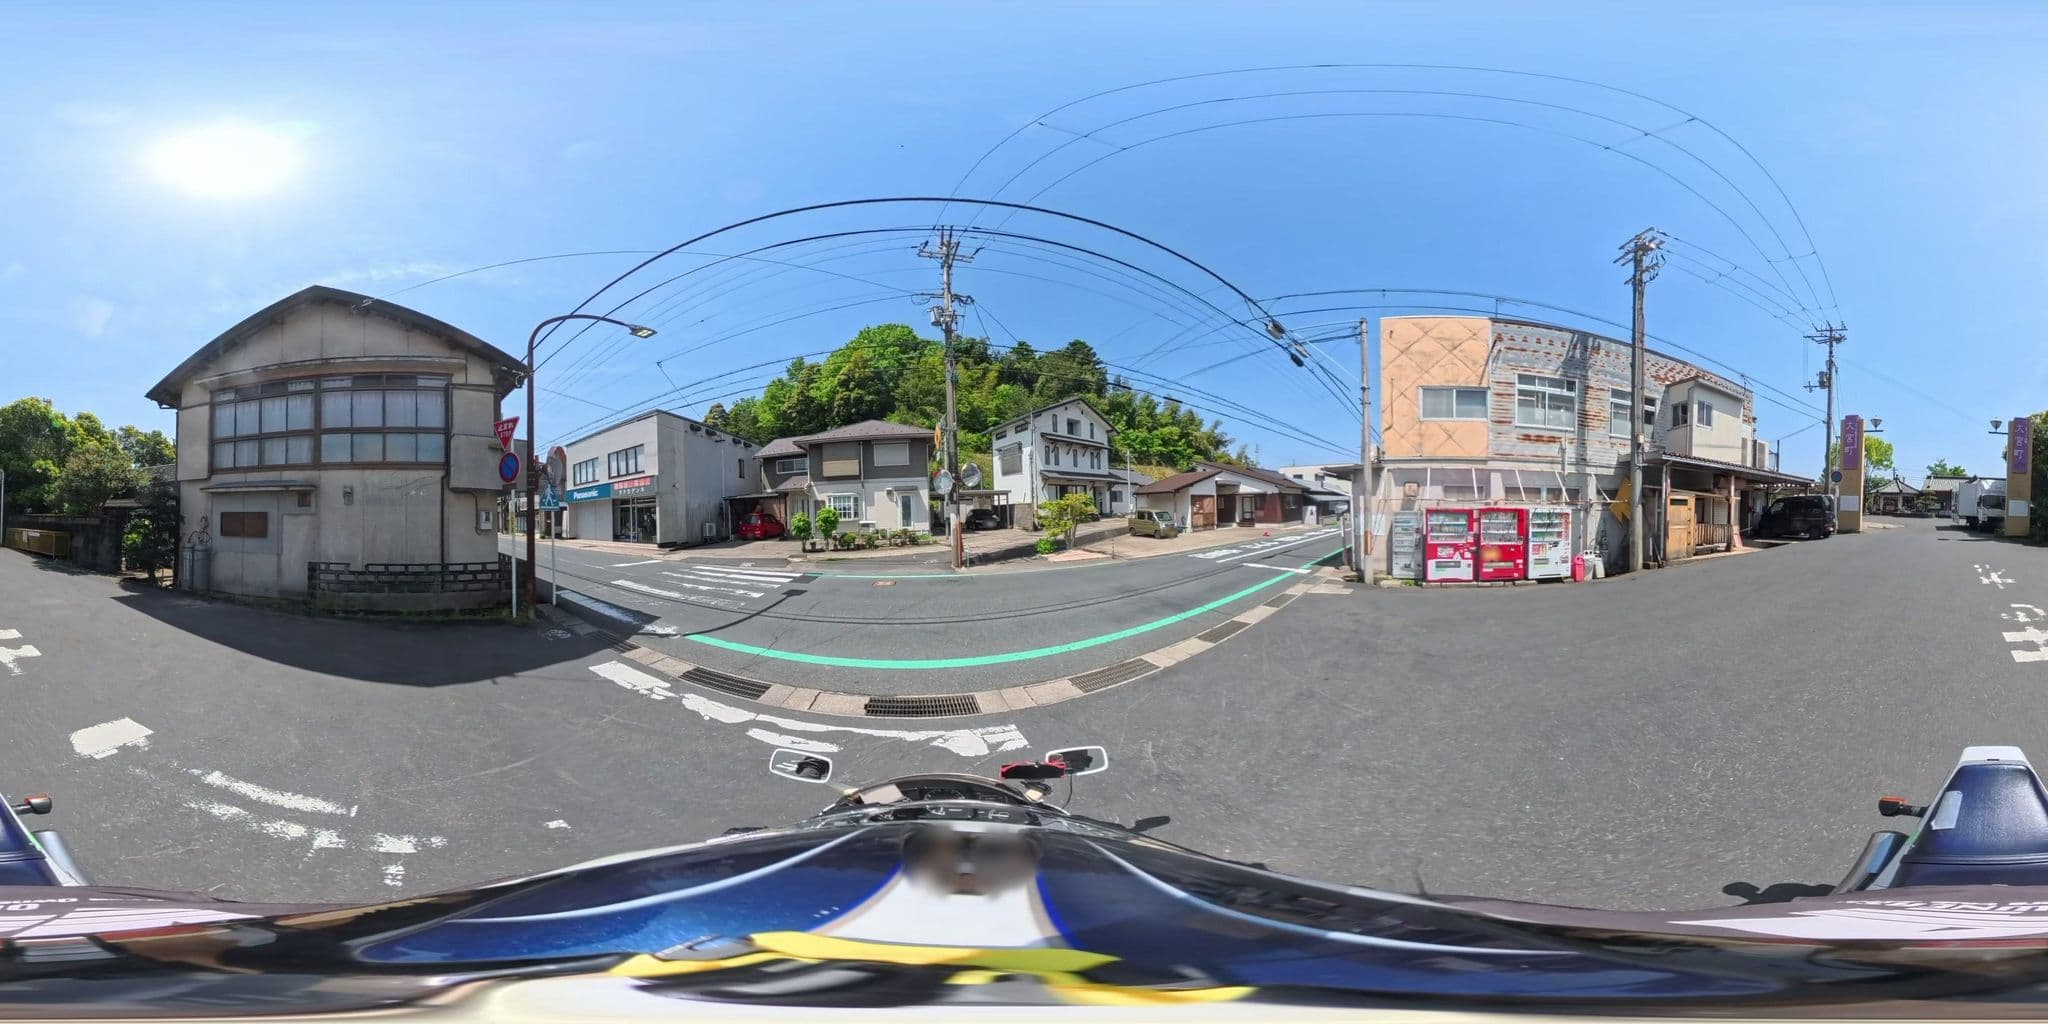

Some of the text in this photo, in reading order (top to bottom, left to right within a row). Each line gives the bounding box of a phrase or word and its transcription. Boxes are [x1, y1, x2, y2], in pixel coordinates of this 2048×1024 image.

[498, 422, 514, 431] 止まれ
[573, 488, 598, 500] Panasonic
